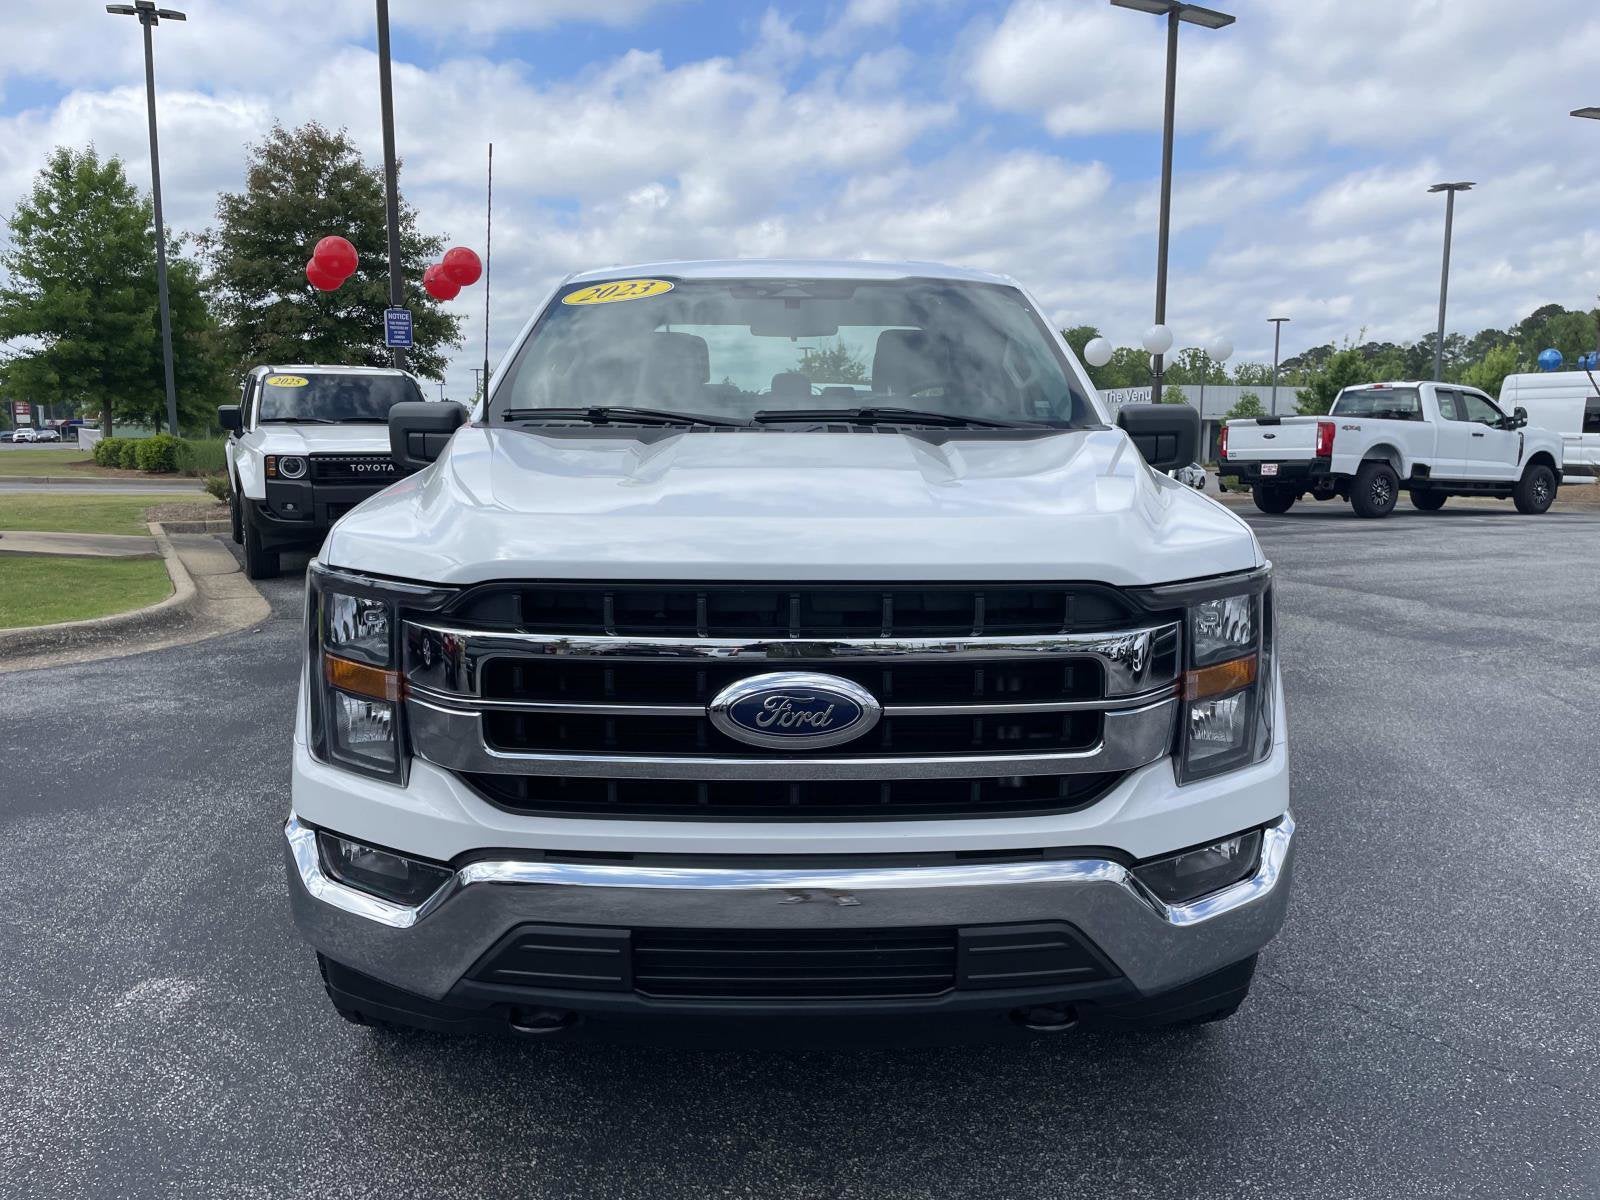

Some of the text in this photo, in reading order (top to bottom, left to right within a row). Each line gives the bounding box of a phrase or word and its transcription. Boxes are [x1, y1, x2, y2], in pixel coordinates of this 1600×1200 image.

[577, 282, 656, 301] 2023
[1104, 389, 1152, 402] The Venu
[350, 464, 395, 472] TOYOTA
[755, 695, 835, 728] Ford
